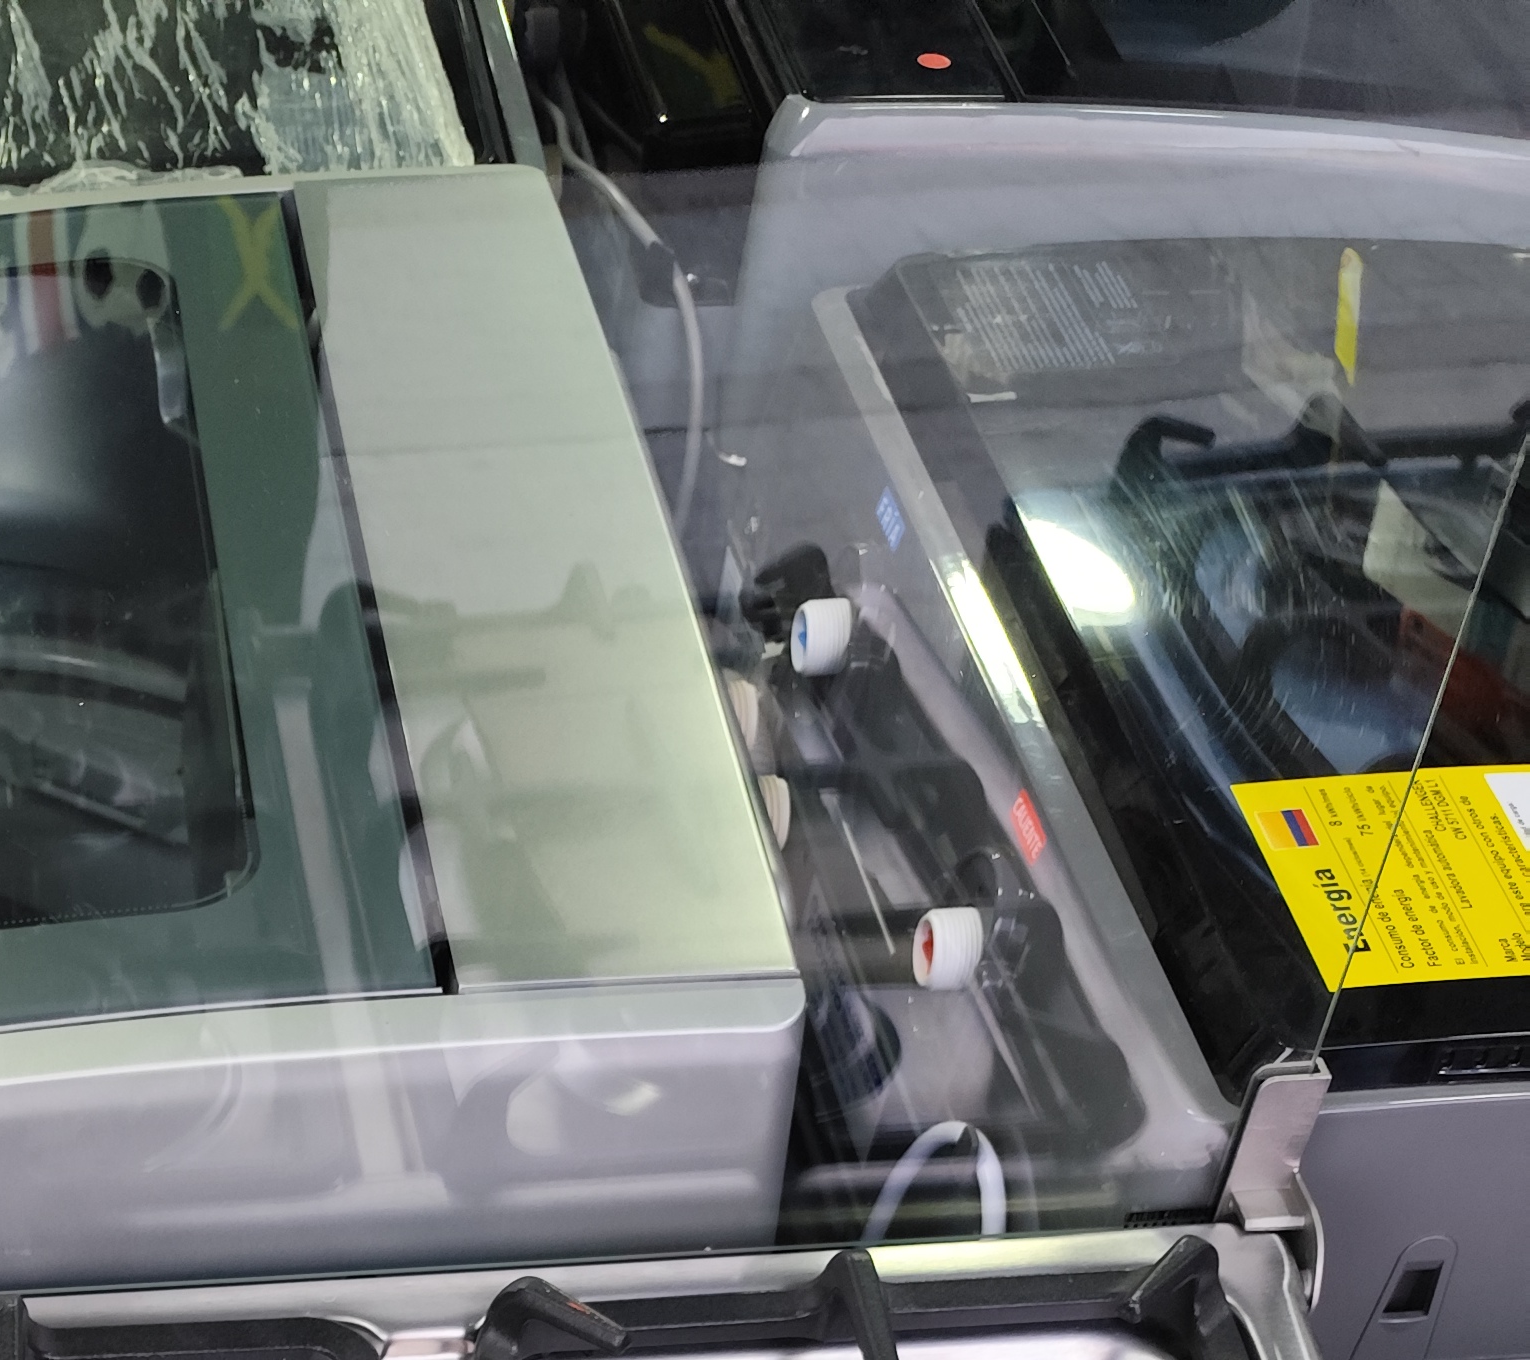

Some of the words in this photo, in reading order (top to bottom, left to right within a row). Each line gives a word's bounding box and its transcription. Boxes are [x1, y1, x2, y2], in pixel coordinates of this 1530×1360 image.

[1429, 789, 1450, 808] DGM
[1460, 795, 1471, 806] de
[1356, 823, 1374, 837] 75
[1466, 808, 1485, 830] otros
[1451, 827, 1467, 841] CW
[1480, 831, 1495, 848] con
[1423, 829, 1452, 870] automática
[1490, 849, 1512, 879] equipo
[1446, 872, 1473, 909] Lavadora
[1508, 881, 1524, 900] este
[1312, 868, 1371, 953] Energía
[1377, 911, 1391, 923] de
[1392, 889, 1419, 922] energía
[1411, 924, 1425, 935] de
[1436, 919, 1458, 952] consumo
[1385, 924, 1415, 969] Consumo
[1418, 937, 1443, 967] Factor
[1498, 938, 1518, 962] Marca
